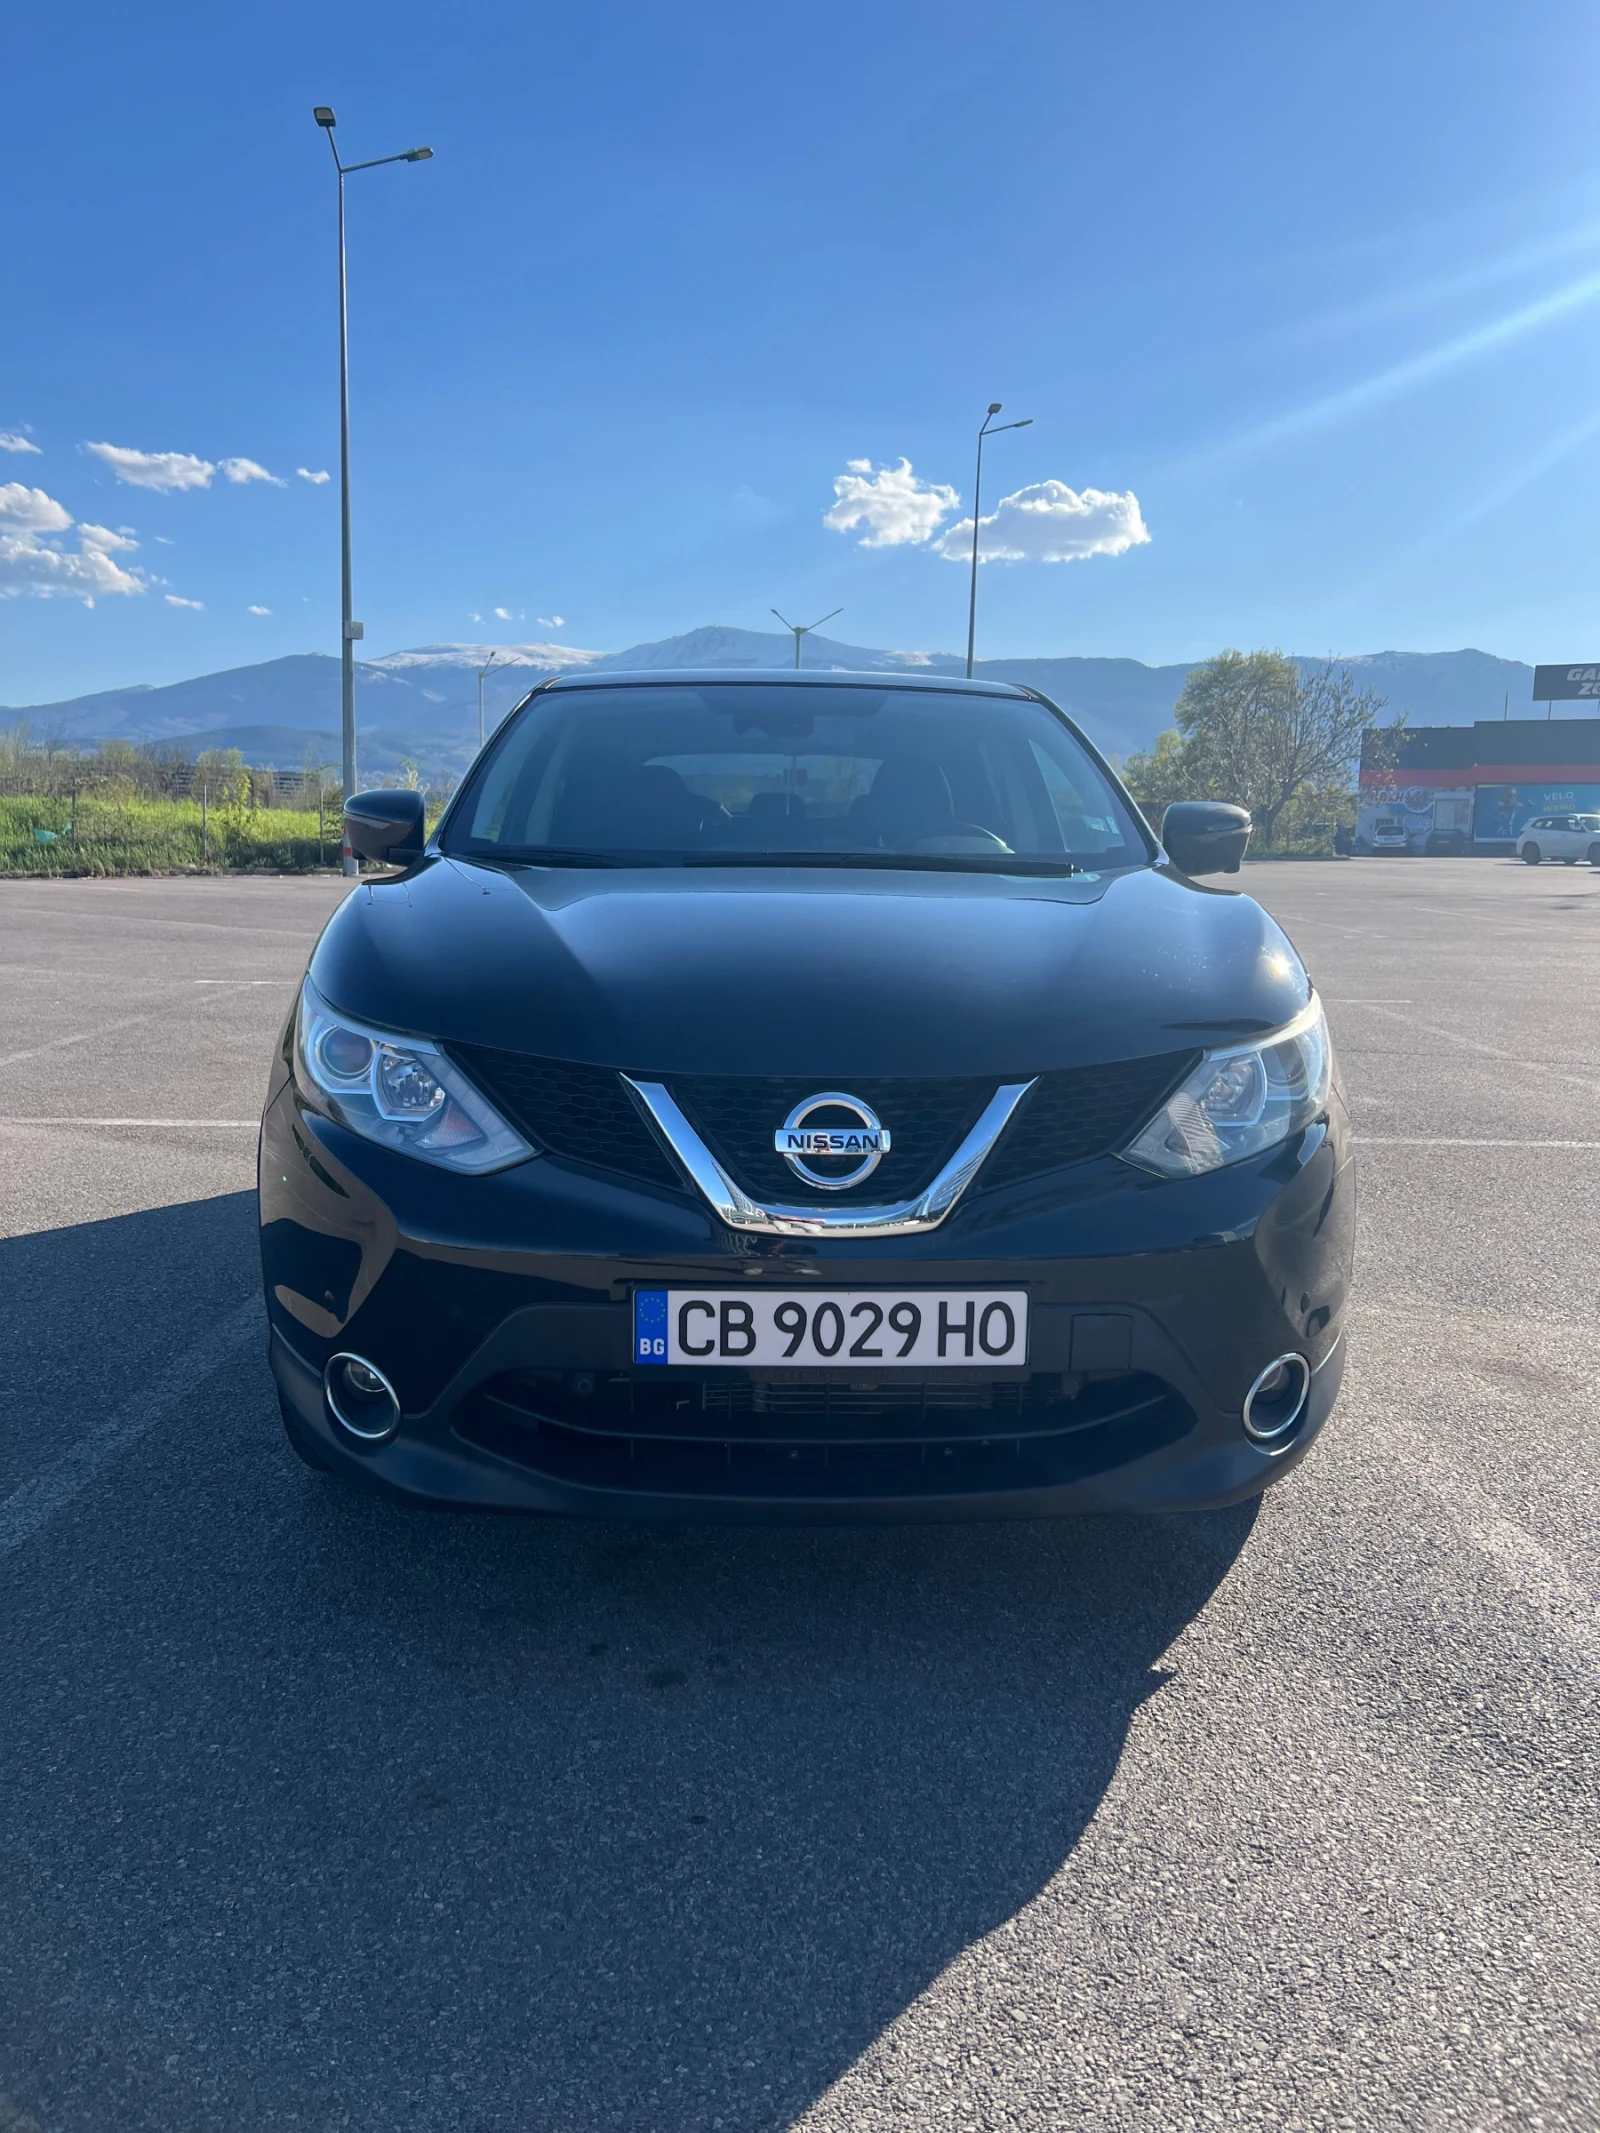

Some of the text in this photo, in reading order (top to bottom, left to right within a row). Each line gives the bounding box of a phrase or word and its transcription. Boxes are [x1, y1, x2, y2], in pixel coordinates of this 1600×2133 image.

[1567, 668, 1600, 681] GA
[1543, 791, 1574, 801] VELO
[788, 1134, 879, 1149] NISSAN
[678, 1300, 1016, 1357] CB 9029 HO
[639, 1338, 665, 1355] BG
